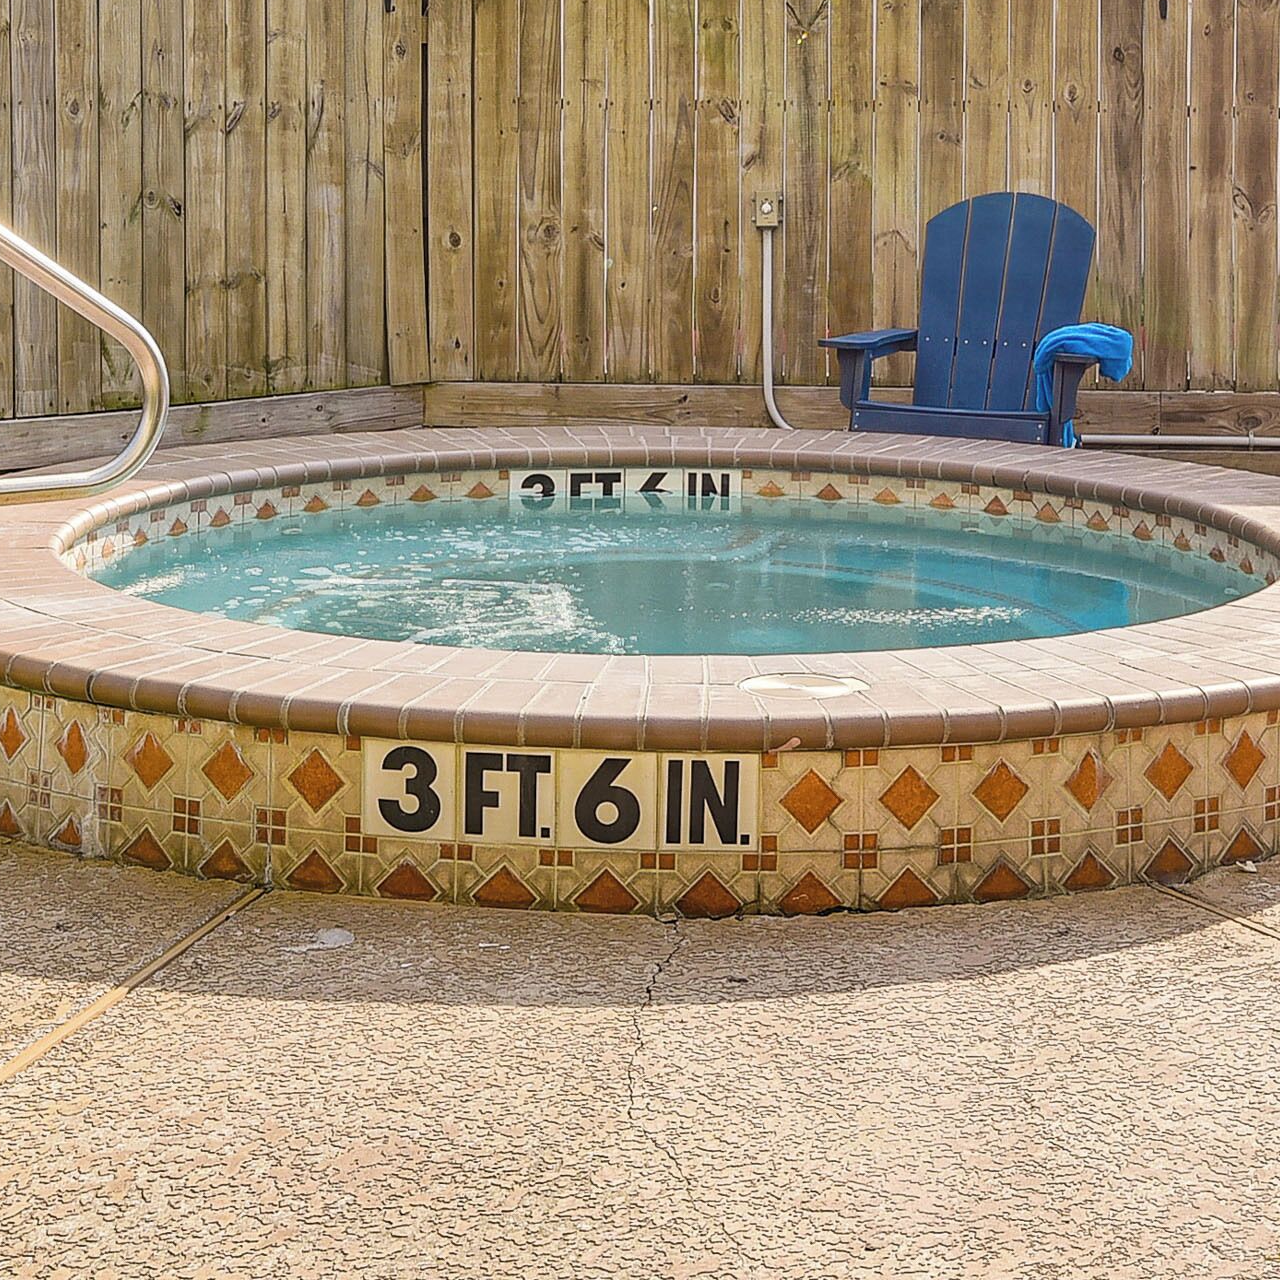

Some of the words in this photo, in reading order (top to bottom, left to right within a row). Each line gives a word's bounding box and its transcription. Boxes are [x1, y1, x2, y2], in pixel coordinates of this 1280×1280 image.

[378, 746, 441, 833] 3
[464, 752, 551, 838] FT.
[574, 758, 641, 845] 6
[665, 759, 751, 846] IN.
